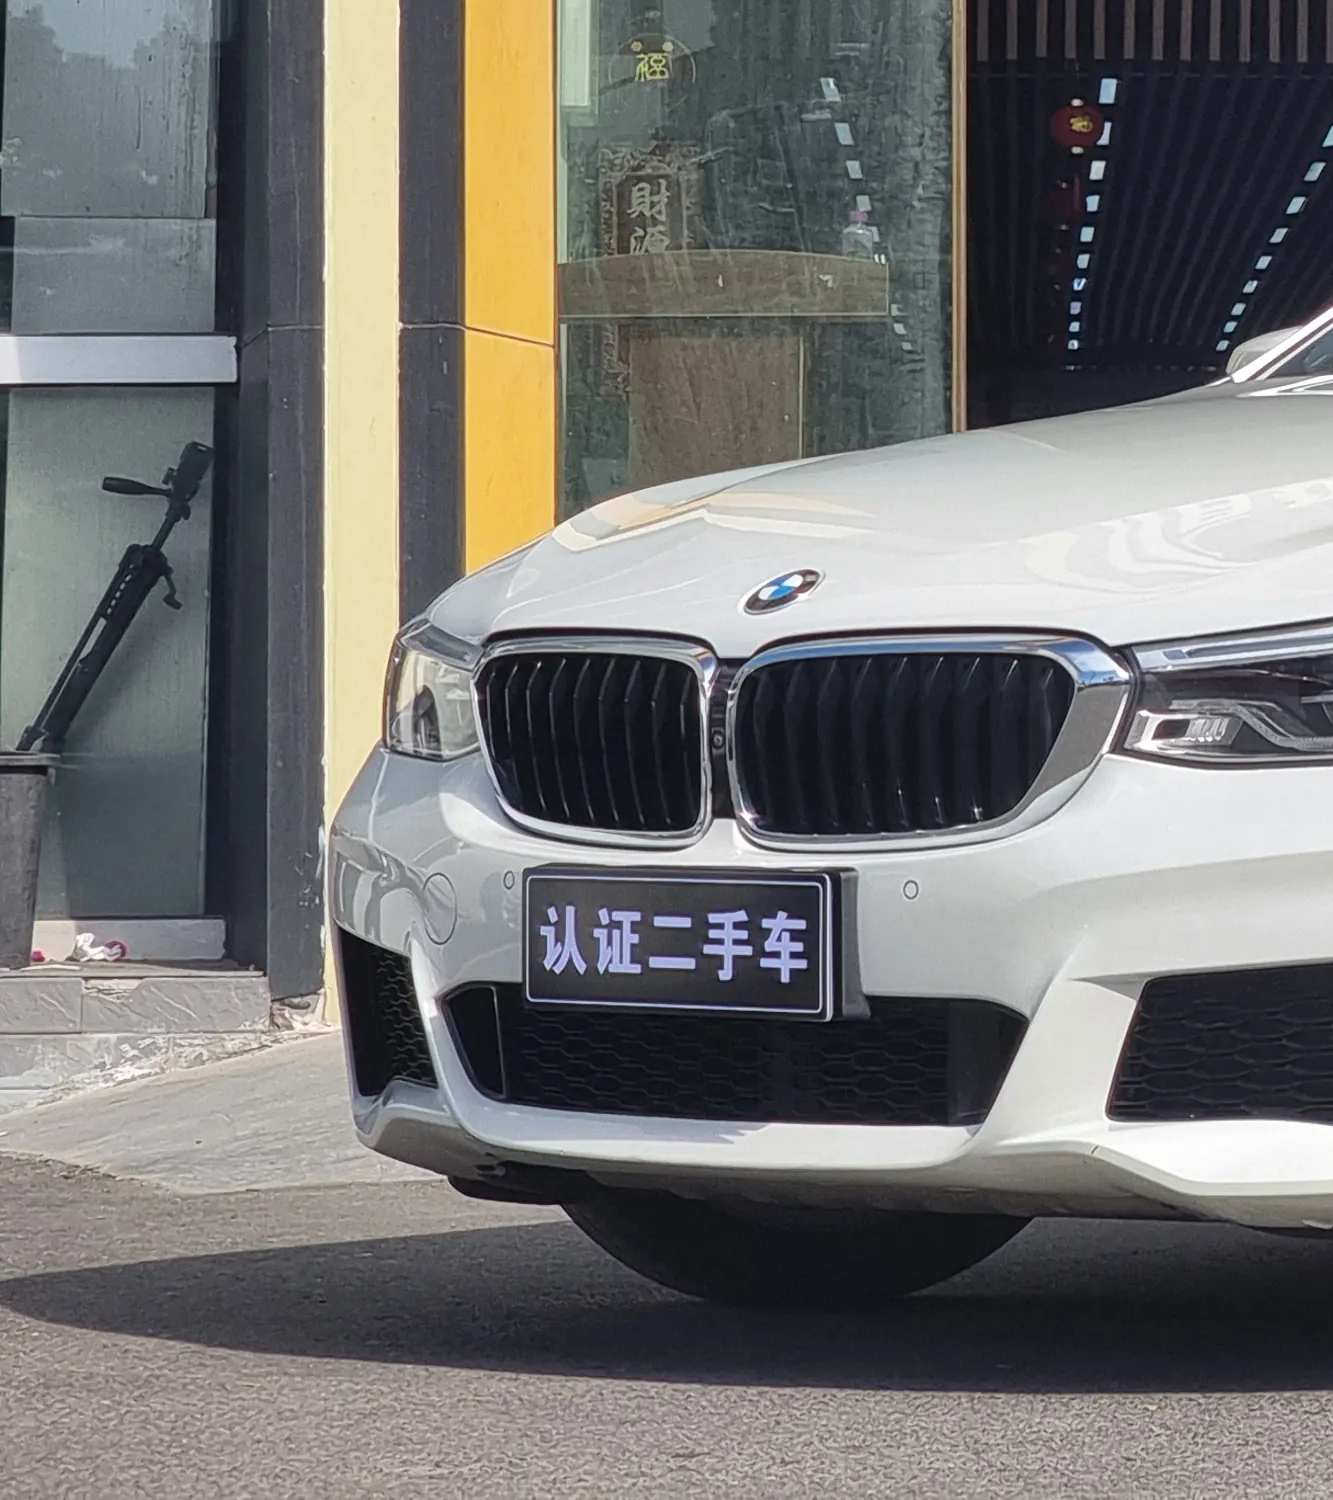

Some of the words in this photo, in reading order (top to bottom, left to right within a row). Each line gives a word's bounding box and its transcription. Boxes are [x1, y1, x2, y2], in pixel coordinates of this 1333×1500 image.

[539, 905, 808, 983] 认证二手车
